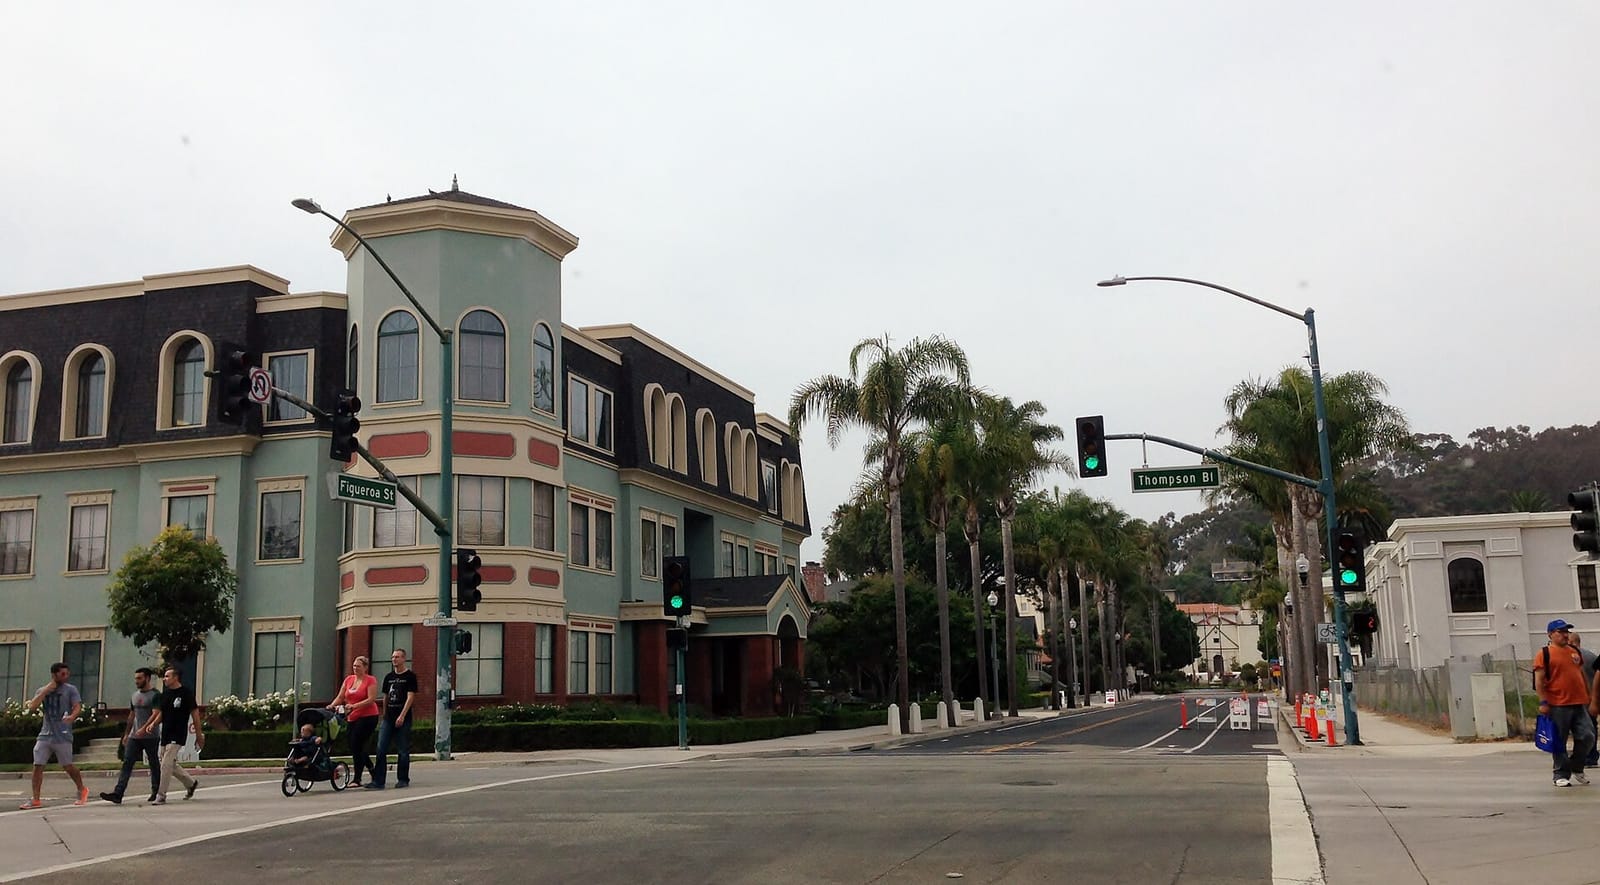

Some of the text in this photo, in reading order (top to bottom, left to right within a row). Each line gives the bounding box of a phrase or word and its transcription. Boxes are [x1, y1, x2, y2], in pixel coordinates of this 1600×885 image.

[1138, 472, 1214, 486] Thompson Bl
[340, 480, 394, 501] Figueroa St
